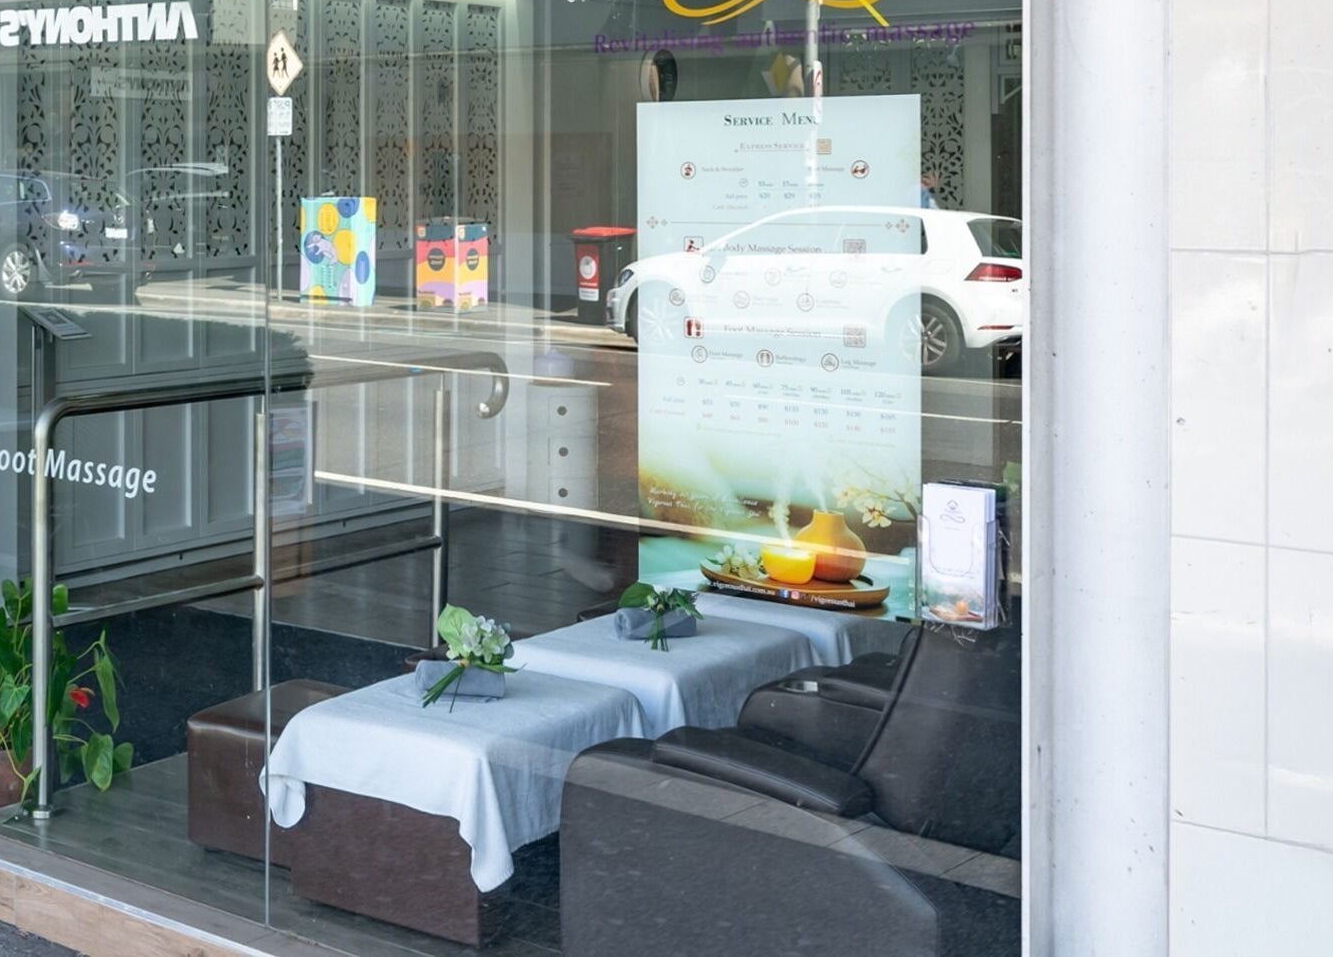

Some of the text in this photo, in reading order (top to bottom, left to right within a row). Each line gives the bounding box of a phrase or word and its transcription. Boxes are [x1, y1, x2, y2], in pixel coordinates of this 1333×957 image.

[866, 21, 975, 44] massage
[723, 114, 773, 127] SERVICE
[44, 448, 158, 499] Massage
